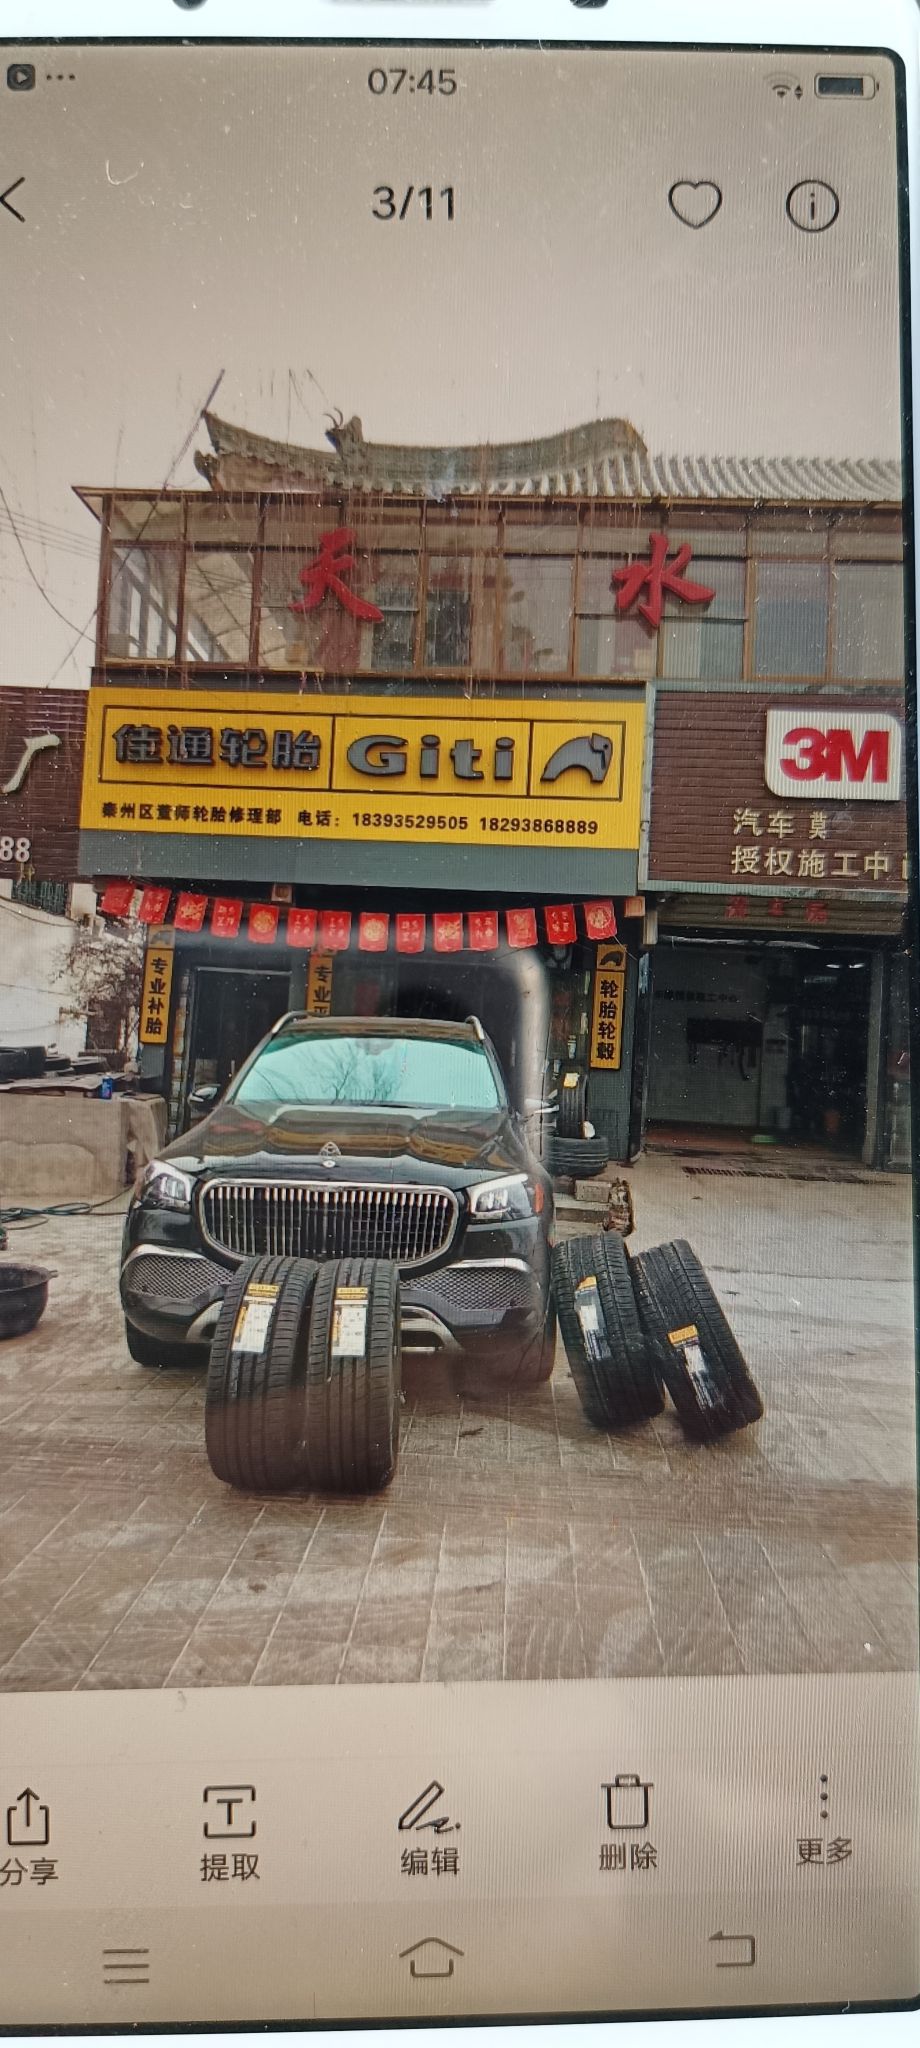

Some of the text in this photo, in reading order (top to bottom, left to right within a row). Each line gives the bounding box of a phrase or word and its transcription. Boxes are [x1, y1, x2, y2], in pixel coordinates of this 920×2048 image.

[367, 67, 457, 95] 07:45
[371, 185, 455, 220] 3/11
[291, 527, 717, 629] 天 水
[111, 723, 322, 771] 佳通轮胎
[346, 733, 516, 781] Giti
[779, 727, 890, 784] 3M
[352, 812, 469, 830] 18393529505
[479, 816, 599, 835] 18293868889
[145, 957, 168, 1036] 专业补胎
[596, 979, 619, 1060] 轮胎轮毂
[400, 1846, 461, 1876] 编辑
[599, 1841, 658, 1871] 删除
[795, 1836, 852, 1865] 更多
[0, 1856, 59, 1886] 分享
[200, 1852, 261, 1882] 提取
